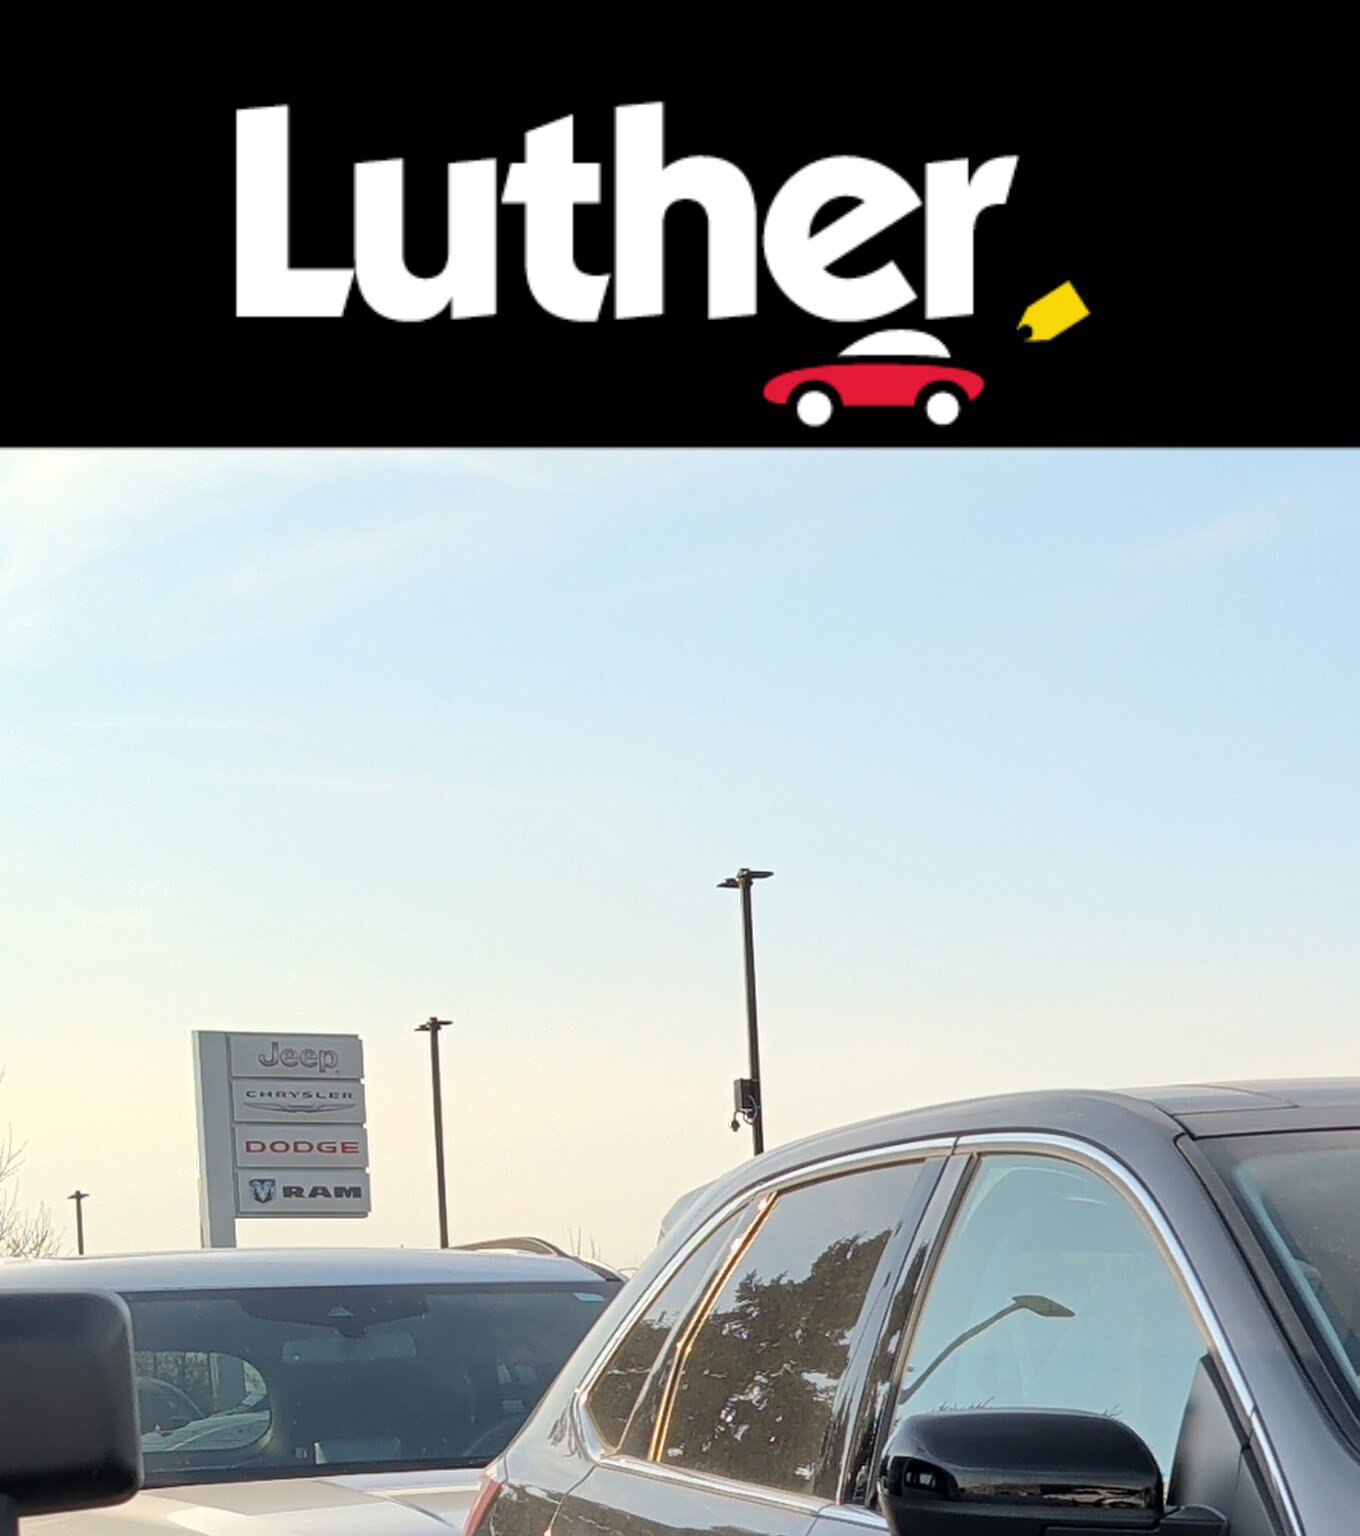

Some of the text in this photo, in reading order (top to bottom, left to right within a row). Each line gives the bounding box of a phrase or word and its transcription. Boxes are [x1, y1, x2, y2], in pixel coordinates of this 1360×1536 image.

[258, 1042, 339, 1073] Jeep
[246, 1090, 353, 1100] CHRYSLER
[245, 1141, 360, 1154] DODGE
[283, 1186, 362, 1199] RAM
